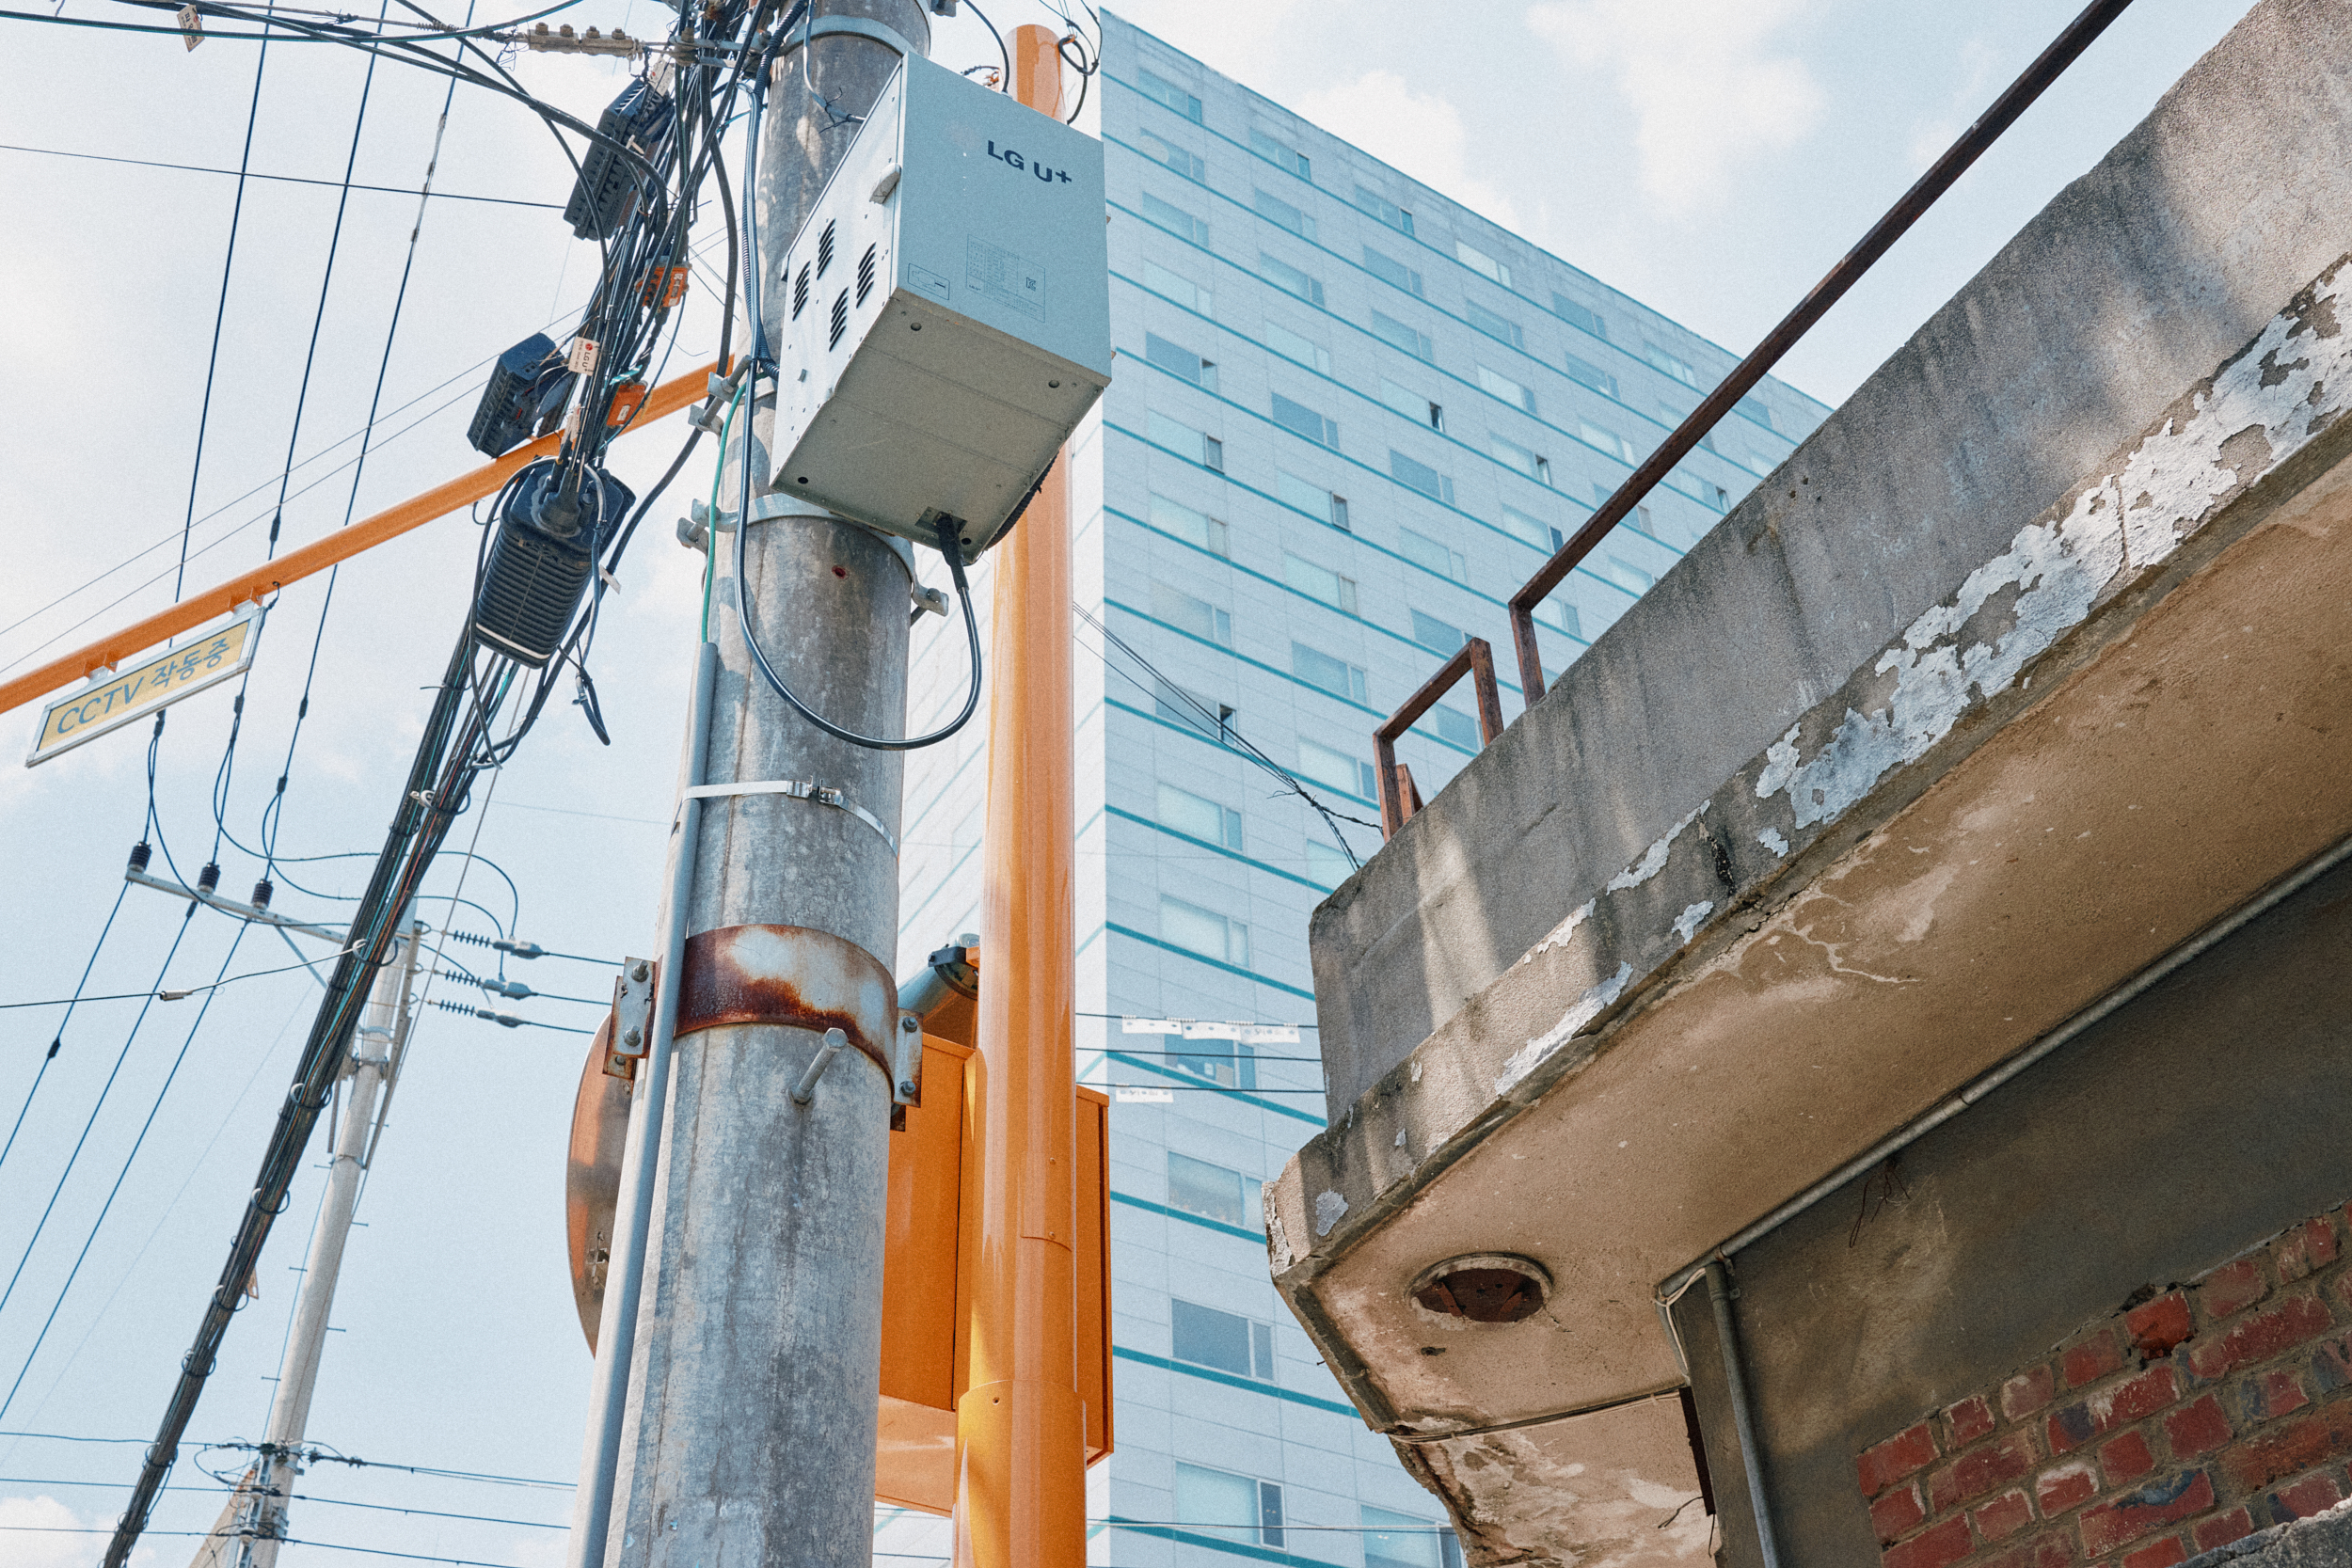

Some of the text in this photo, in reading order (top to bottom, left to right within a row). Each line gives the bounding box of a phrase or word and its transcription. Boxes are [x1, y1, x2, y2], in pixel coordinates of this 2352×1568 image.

[988, 140, 1073, 183] LG U+
[583, 351, 591, 361] LG
[56, 637, 230, 735] CCTV 작동중
